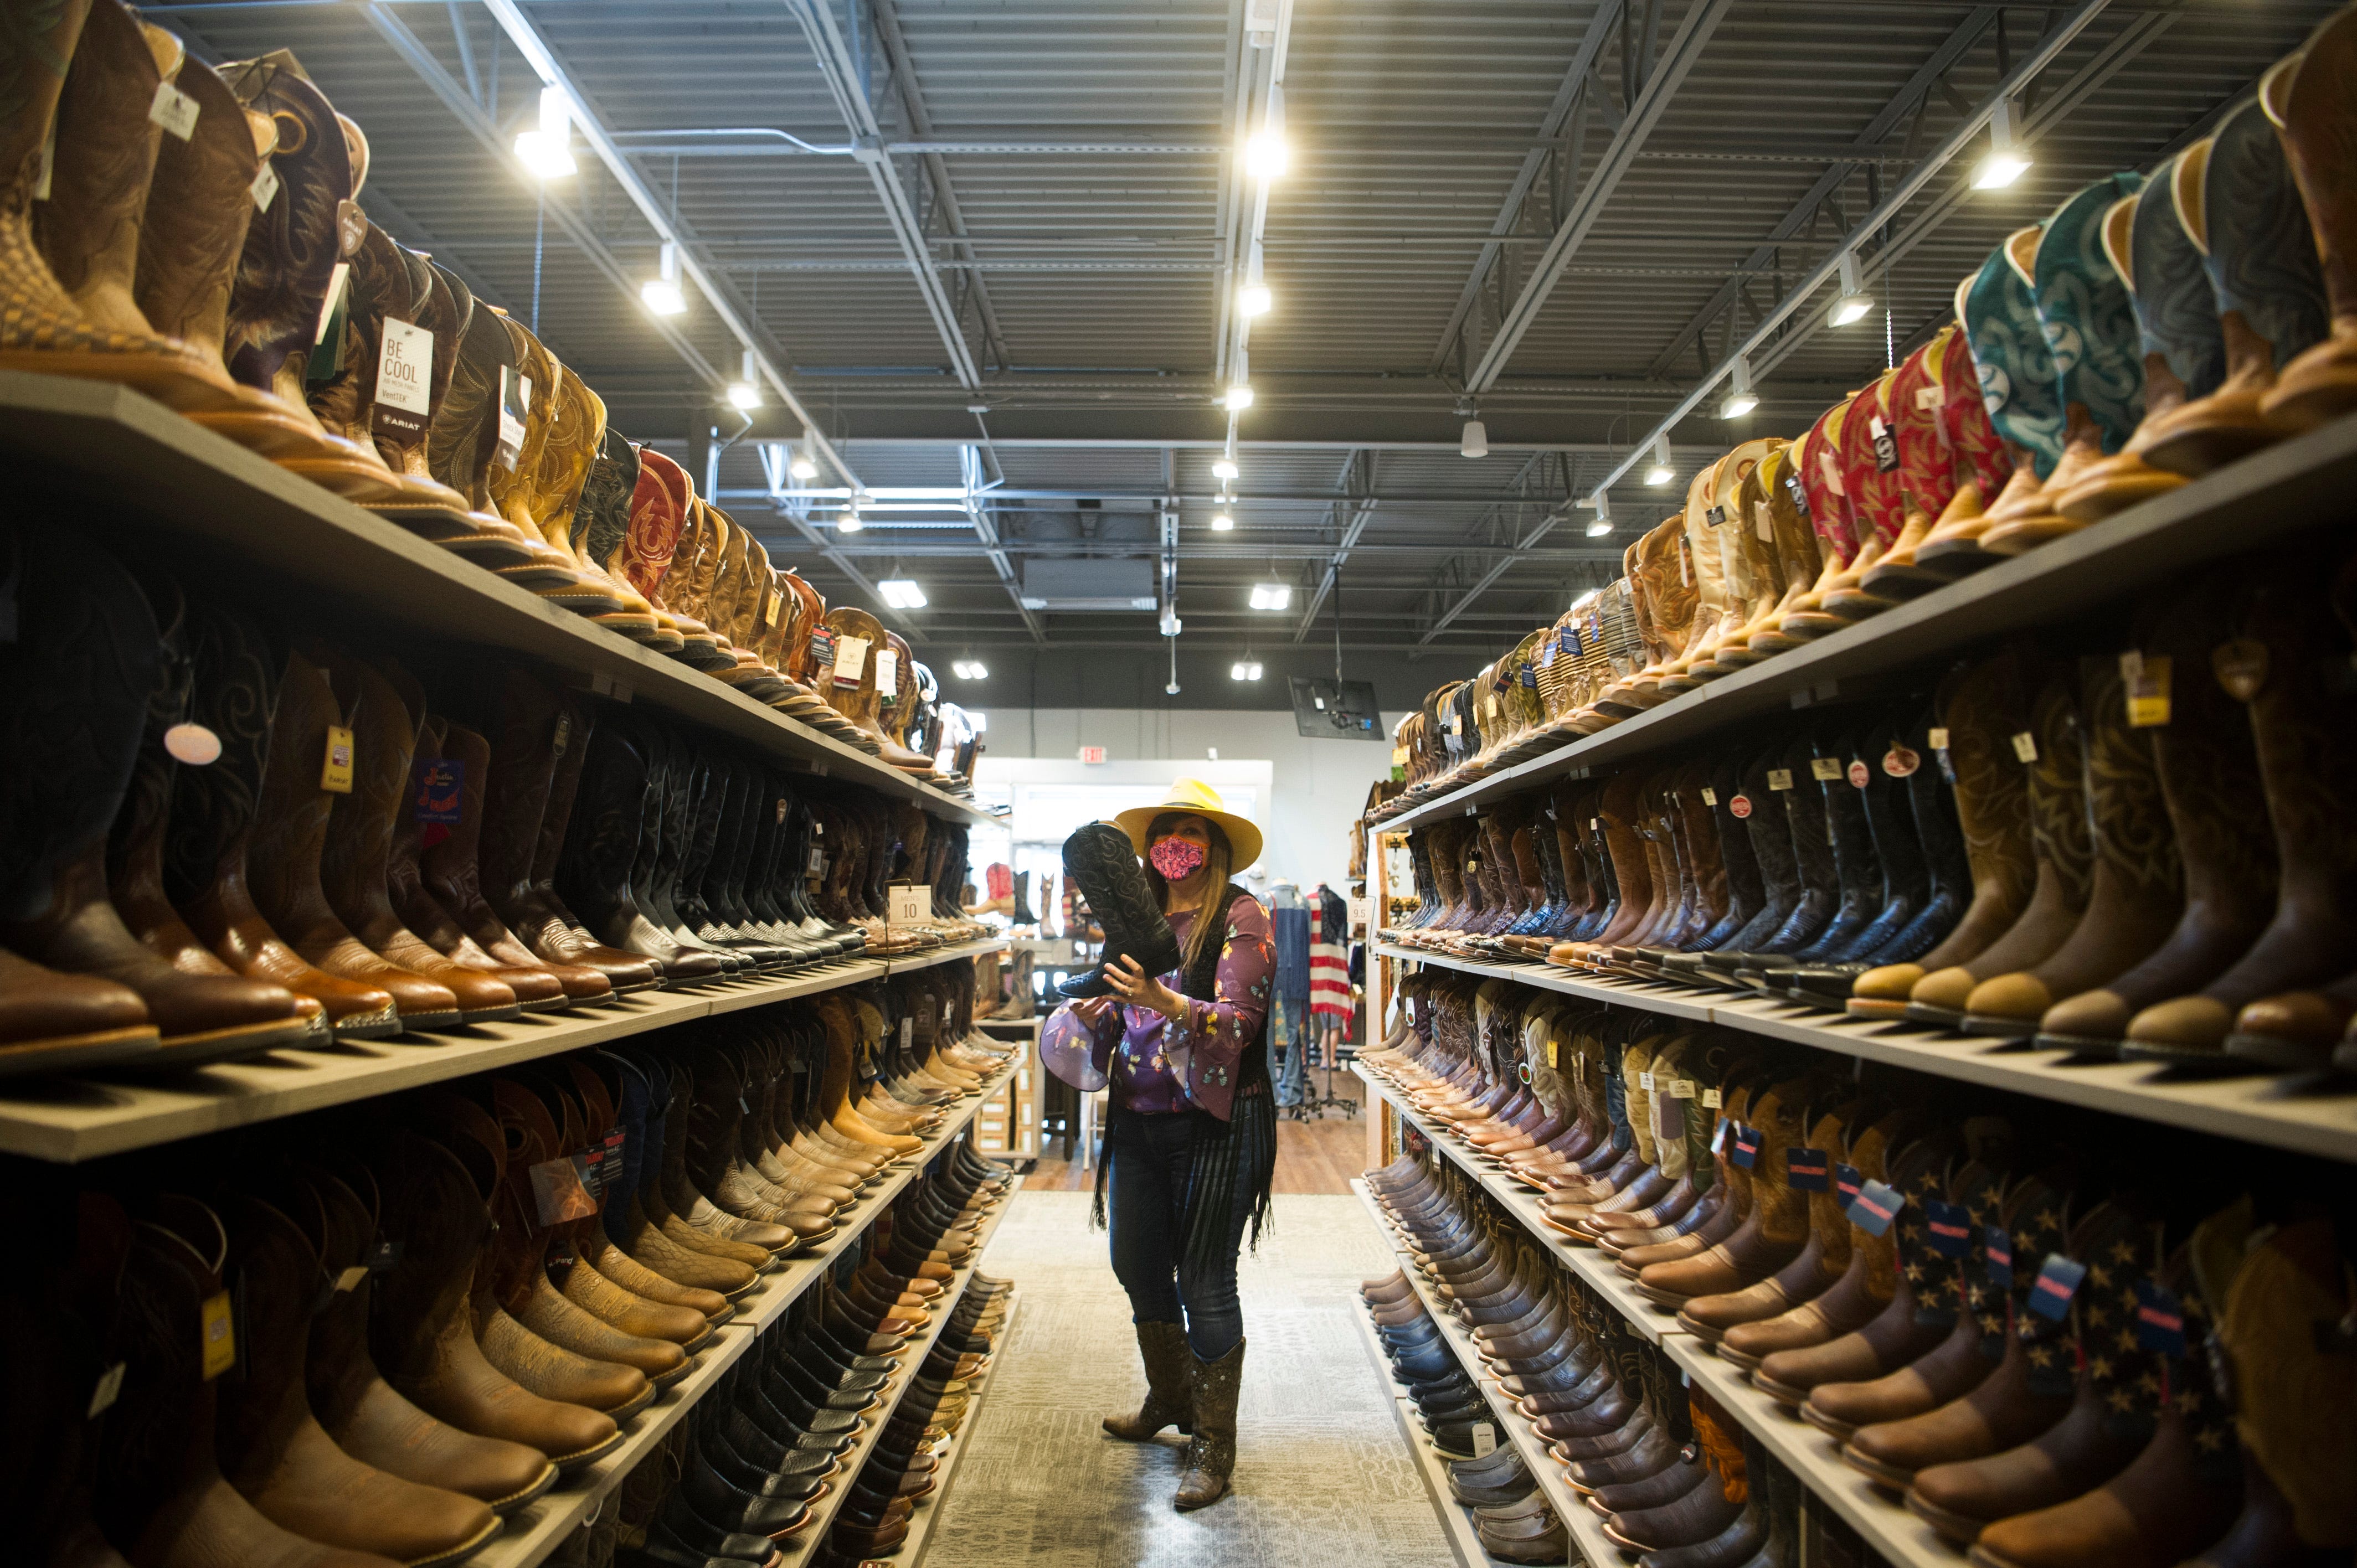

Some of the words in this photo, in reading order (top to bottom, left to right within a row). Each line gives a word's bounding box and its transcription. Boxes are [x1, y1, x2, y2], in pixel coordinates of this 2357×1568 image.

[387, 338, 403, 359] BE
[385, 359, 417, 383] COOL
[382, 389, 407, 403] VentTEK
[391, 419, 420, 431] ARIAT
[1084, 747, 1102, 762] EXIT
[904, 904, 917, 918] 10
[1354, 909, 1366, 918] 9.5
